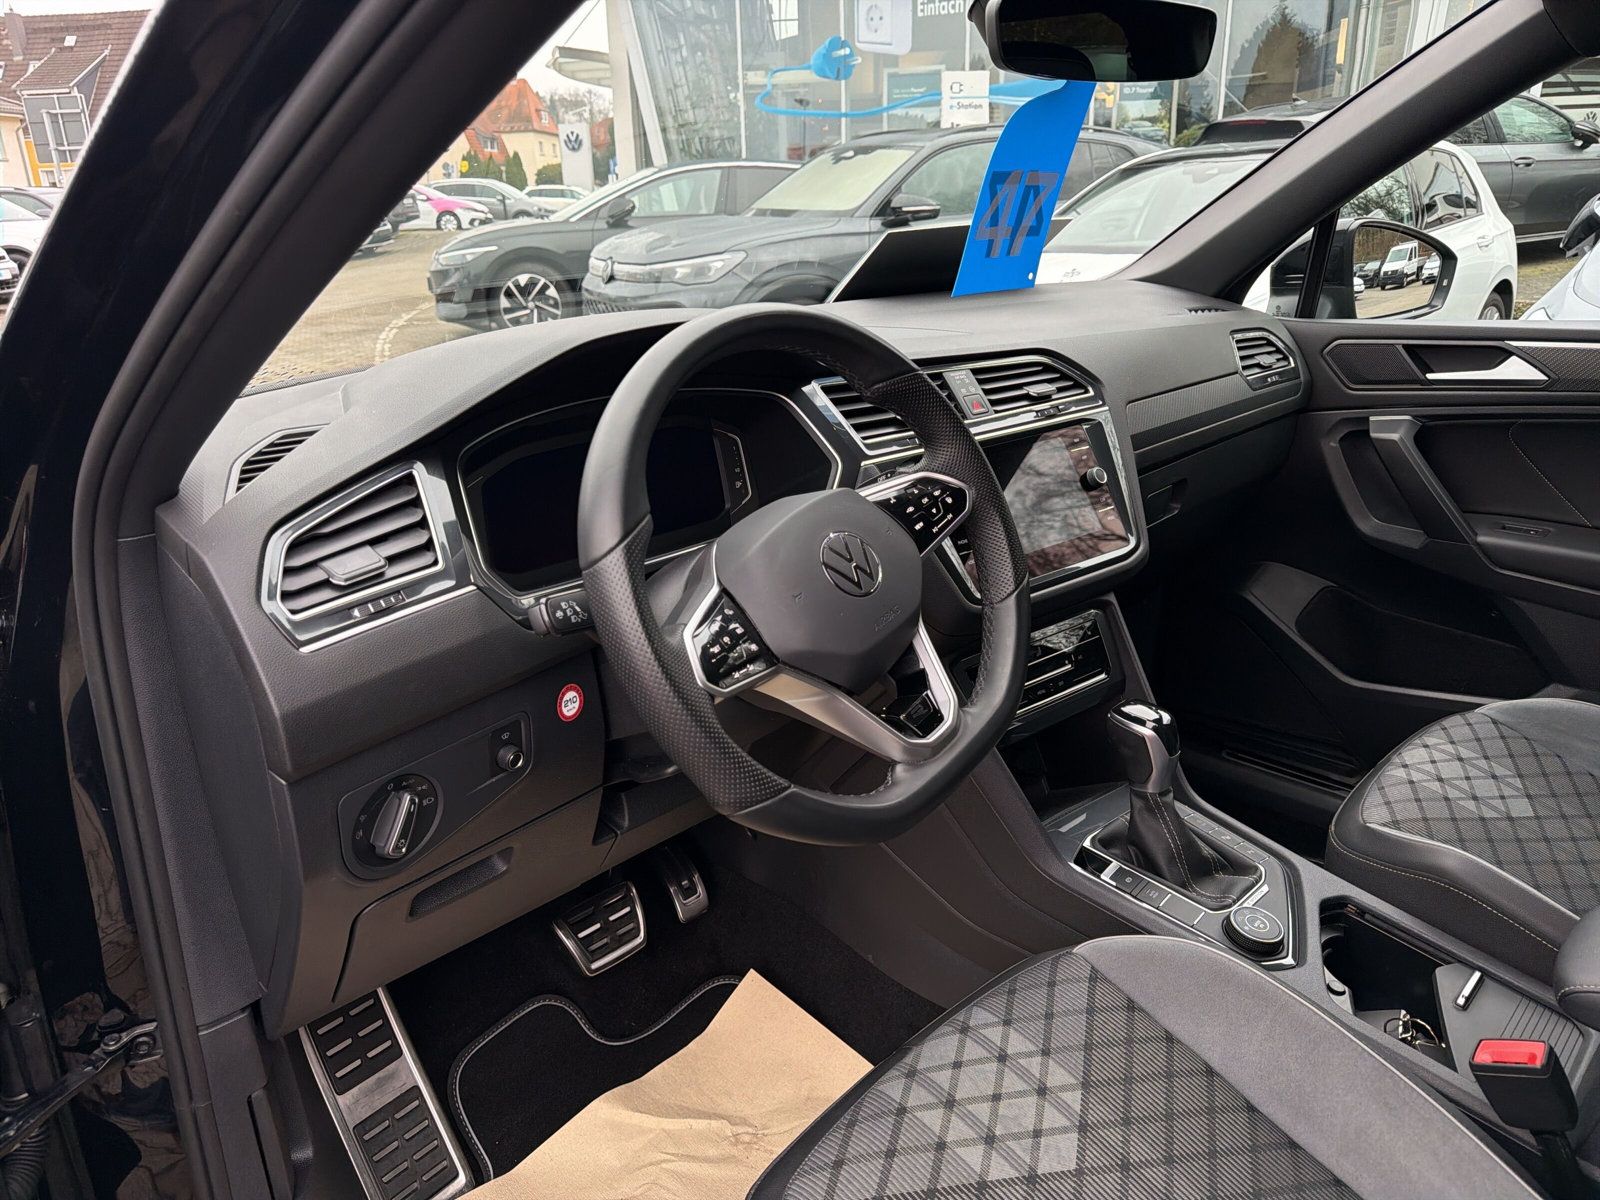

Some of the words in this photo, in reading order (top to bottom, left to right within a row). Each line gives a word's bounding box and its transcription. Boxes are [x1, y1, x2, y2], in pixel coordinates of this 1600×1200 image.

[917, 0, 964, 17] Einfach
[949, 101, 983, 110] e-Station
[975, 170, 1060, 258] 47
[564, 695, 578, 708] 210
